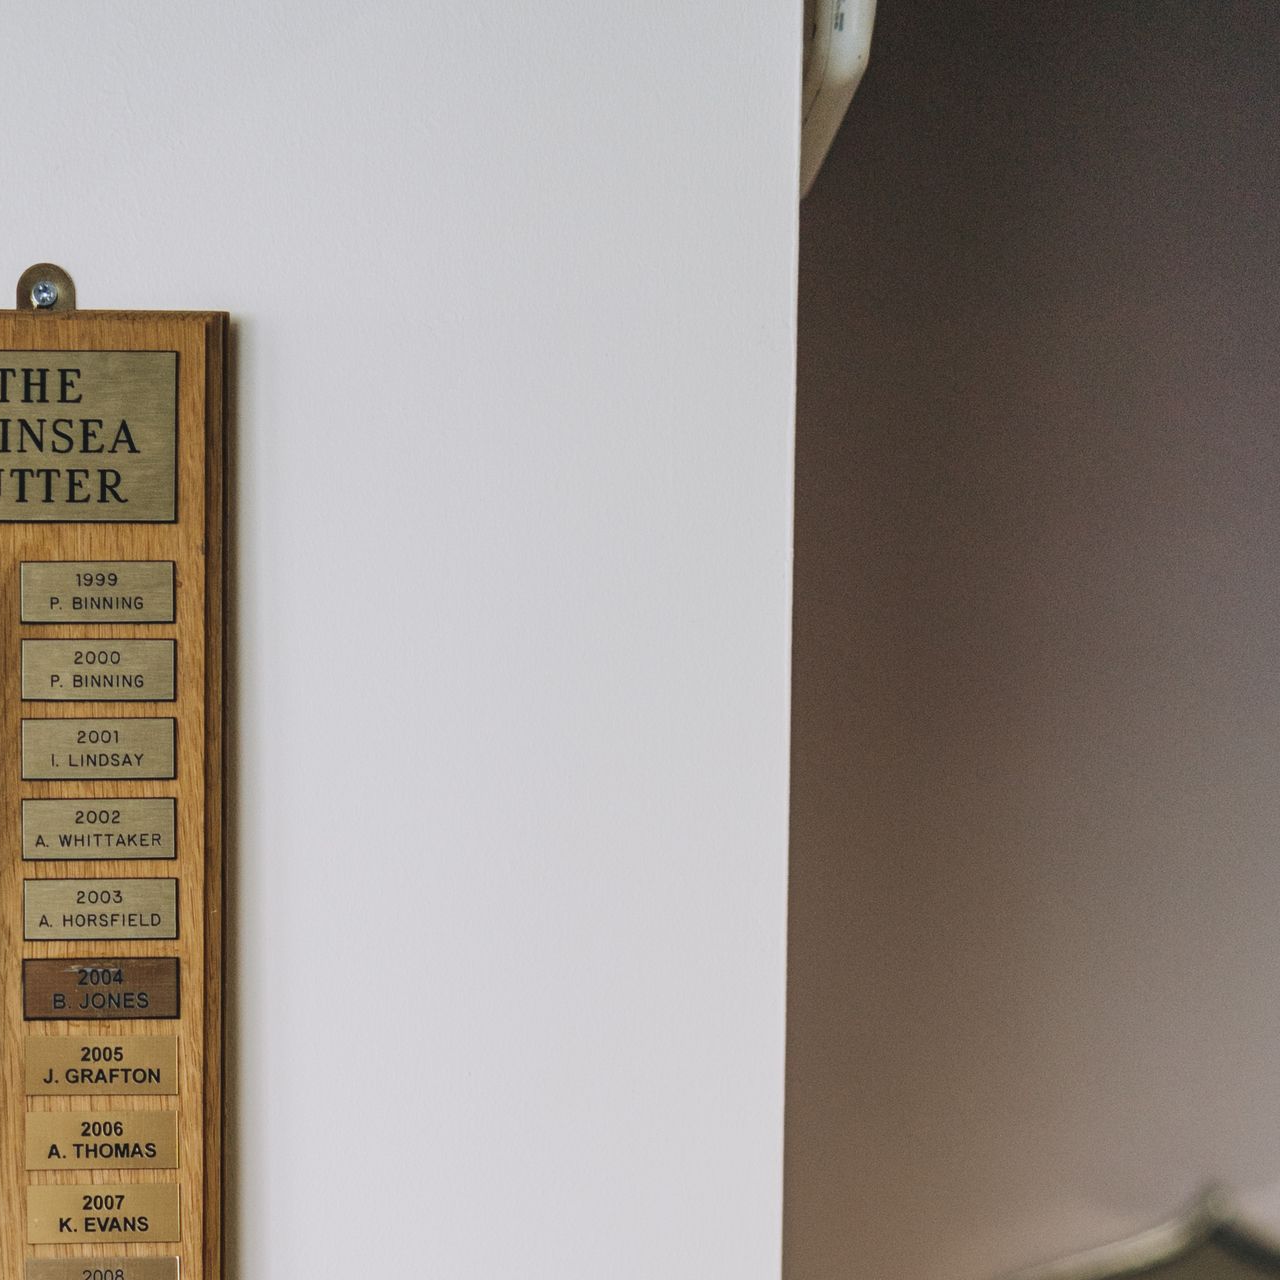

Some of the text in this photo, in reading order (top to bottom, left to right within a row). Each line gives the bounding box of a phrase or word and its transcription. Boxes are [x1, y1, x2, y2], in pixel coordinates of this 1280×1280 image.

[76, 573, 119, 587] 1999
[50, 596, 144, 610] P. BINNING
[74, 651, 121, 665] 2000
[50, 675, 144, 688] P. BINNING
[77, 731, 119, 744] 2001
[51, 753, 144, 767] I. LINDSAY
[75, 810, 121, 824] 2002
[35, 833, 162, 847] A. WHITTAKER
[76, 891, 123, 904] 2003
[39, 914, 161, 927] A. HORSFIELD
[78, 969, 123, 985] 2004
[53, 992, 149, 1009] B. JONES
[81, 1047, 124, 1062] 2005
[43, 1069, 161, 1083] J. GRAFTON
[81, 1122, 124, 1137] 2006
[47, 1143, 157, 1159] A. THOMAS
[82, 1195, 125, 1210] 2007
[59, 1216, 149, 1232] K. EVANS
